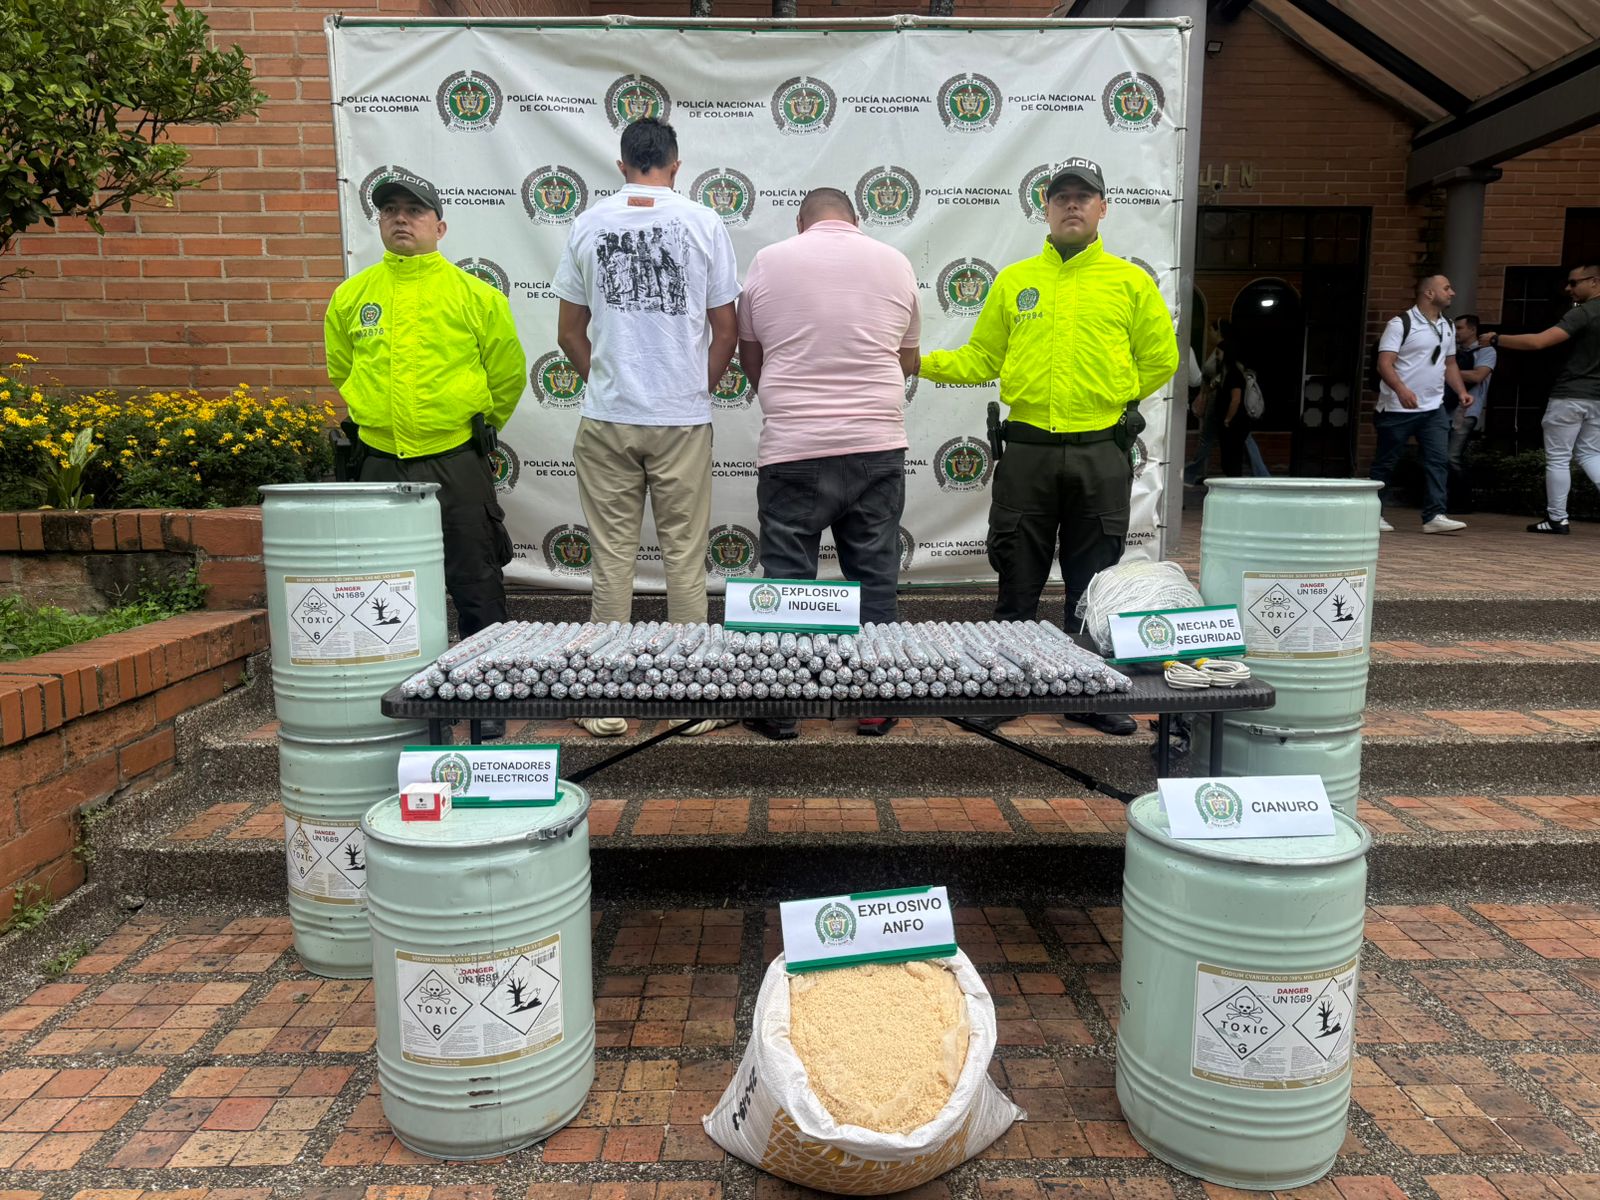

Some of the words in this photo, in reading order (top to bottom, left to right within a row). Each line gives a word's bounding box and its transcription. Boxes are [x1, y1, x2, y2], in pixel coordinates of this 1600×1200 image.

[341, 94, 378, 103] POLICÍA
[381, 95, 432, 103] NACIONAL
[507, 94, 544, 103] POLICÍA
[547, 96, 598, 106] NACIONAL
[842, 95, 879, 104] POLICÍA
[882, 96, 932, 104] NACIONAL
[1008, 93, 1046, 103] POLICÍA
[1048, 94, 1097, 102] NACIONAL
[676, 99, 714, 108] POLICÍA
[717, 101, 767, 109] NACIONAL
[1036, 104, 1084, 112] COLOMBIA
[369, 105, 420, 113] COLOMBIA
[535, 105, 585, 114] COLOMBIA
[467, 188, 517, 196] NACIONAL
[595, 189, 619, 197] POLI
[760, 188, 797, 198] POLICÍA
[925, 187, 962, 196] POLICÍA
[965, 187, 1012, 196] NACIONAL
[1106, 186, 1124, 195] ICÍA
[1126, 188, 1172, 197] NACIONAL
[455, 198, 506, 206] COLOMBIA
[938, 197, 950, 205] DE
[953, 197, 1000, 205] COLOMBIA
[514, 280, 551, 289] POLICÍA
[523, 459, 560, 468] POLICÍA
[723, 462, 756, 470] NACIO
[919, 540, 953, 549] POLICÍA
[945, 550, 989, 558] COLOMBIA
[347, 591, 366, 599] 1689
[781, 587, 849, 598] EXPLOSIVO
[788, 601, 842, 612] INDUGEL
[301, 616, 333, 624] TOXIC
[1177, 620, 1217, 632] MECHA
[1219, 619, 1235, 628] DE
[1272, 625, 1281, 634] 6
[313, 631, 321, 641] 6
[1177, 632, 1242, 645] SEGURIDAD
[472, 761, 551, 771] DETONADORES
[474, 773, 549, 783] INELECTRICOS
[1251, 801, 1319, 813] CIANURO
[858, 897, 942, 918] EXPLOSIVO
[882, 918, 924, 934] ANFO
[1277, 987, 1309, 995] DANGER
[1272, 996, 1288, 1004] UN
[1290, 994, 1313, 1004] 1689
[1221, 1020, 1269, 1035] TOXIC
[1237, 1043, 1248, 1054] 6
